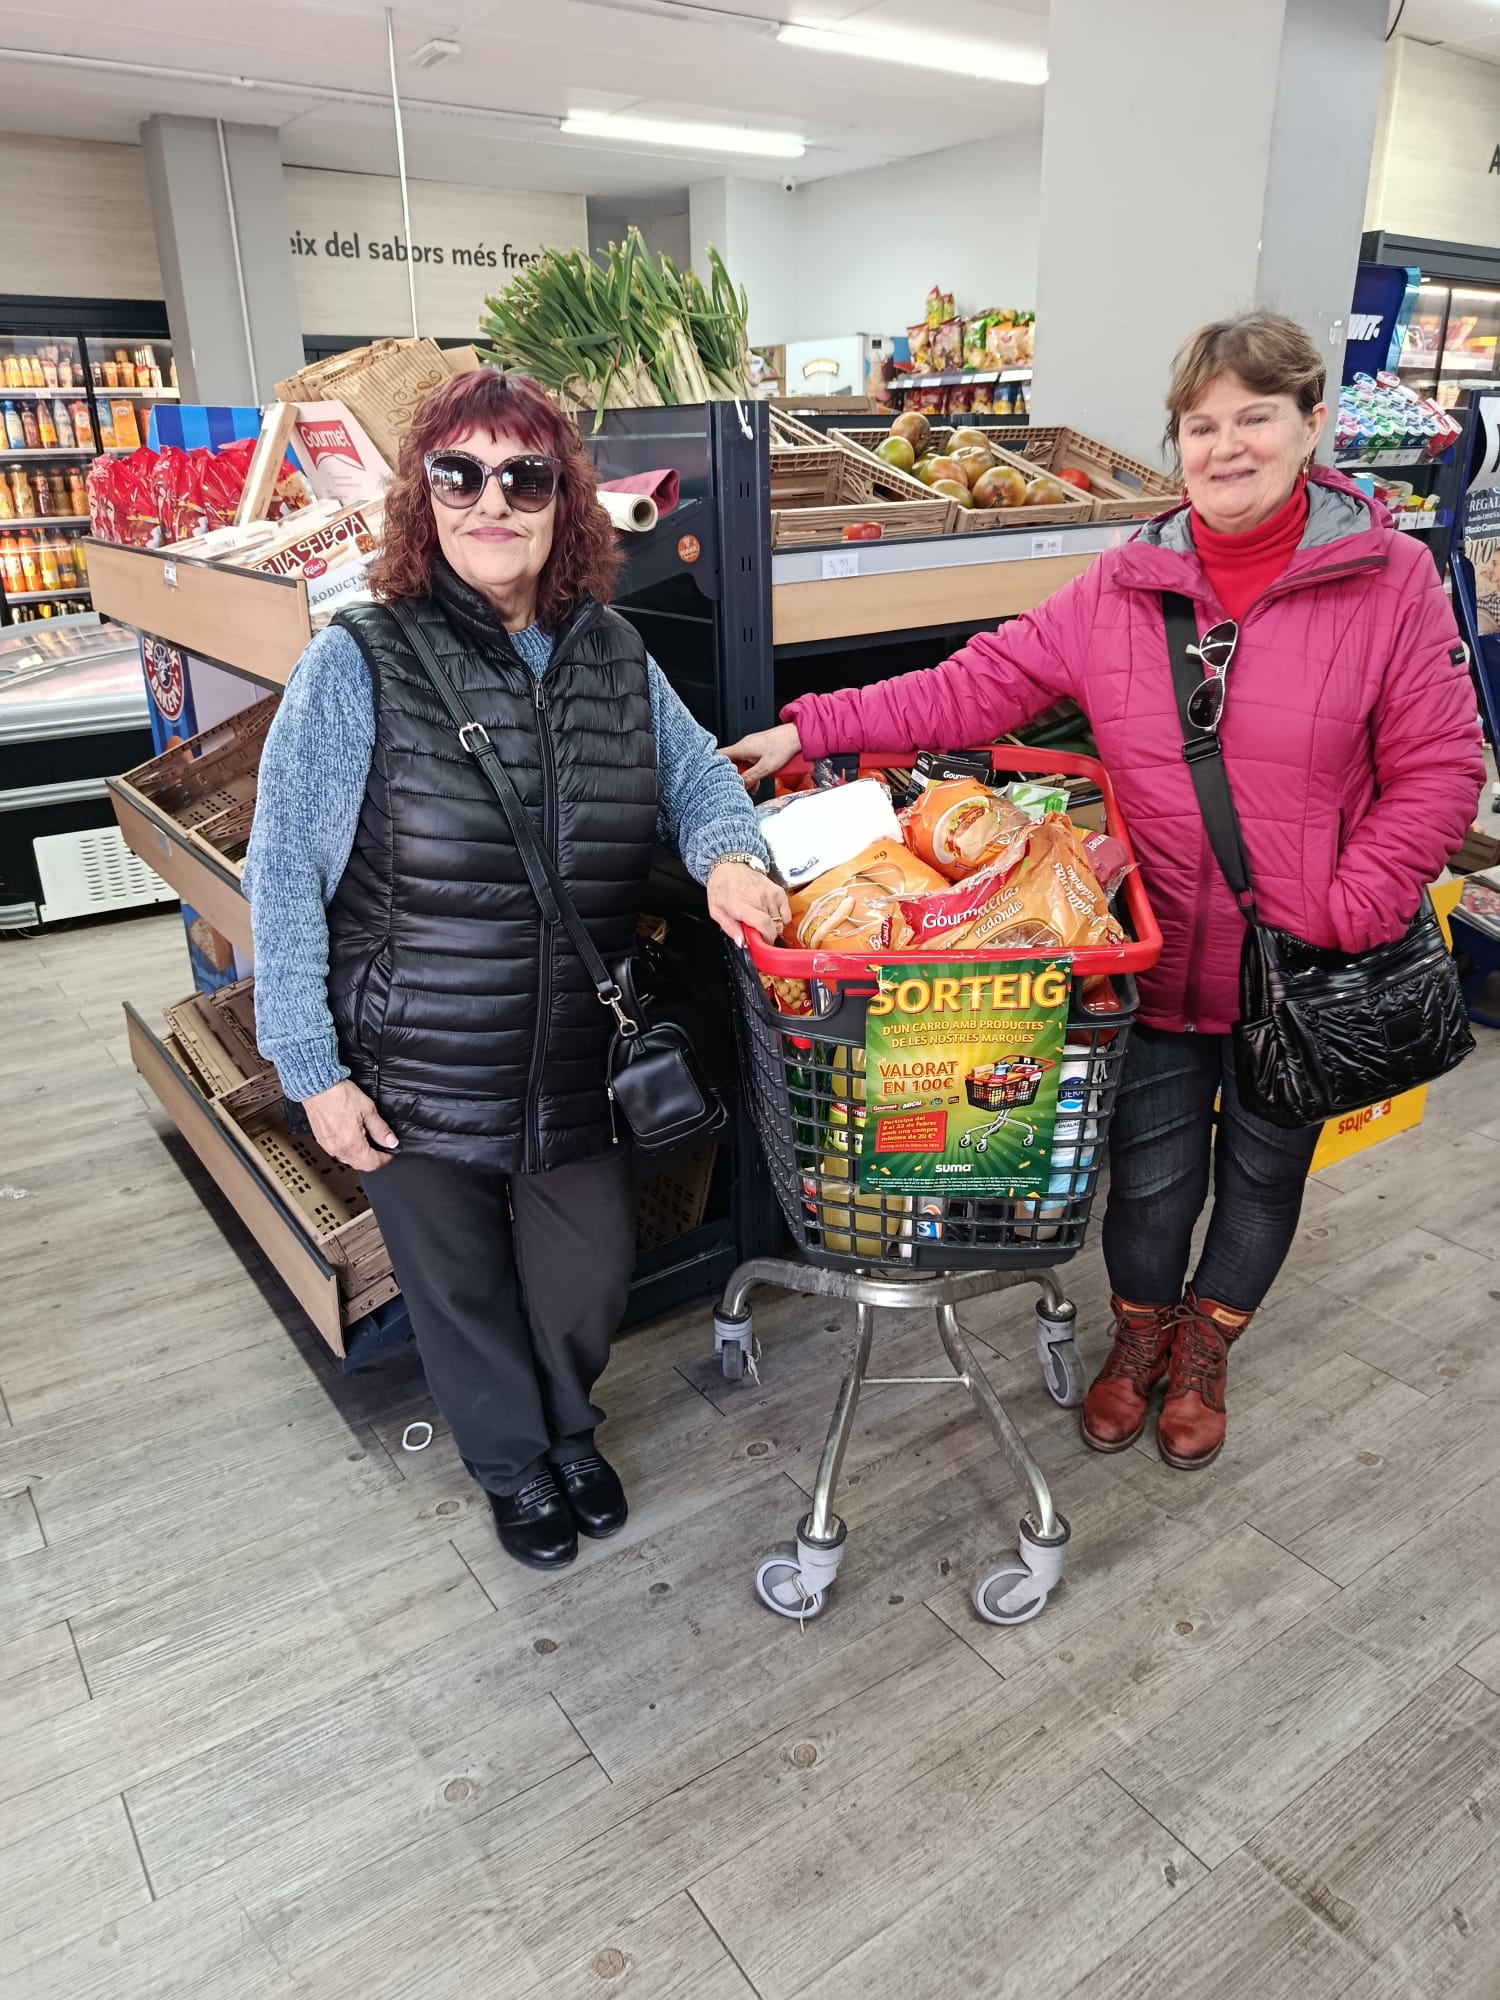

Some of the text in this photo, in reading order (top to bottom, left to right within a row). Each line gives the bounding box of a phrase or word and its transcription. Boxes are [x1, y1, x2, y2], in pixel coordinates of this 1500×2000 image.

[290, 229, 549, 269] ix del sabors més fres
[300, 425, 352, 449] Gourmet
[150, 675, 182, 713] BAKERY
[923, 908, 979, 929] Gourm
[974, 900, 1025, 939] redondas
[867, 970, 1067, 1017] SORTEIG
[882, 1019, 1044, 1037] D'UN CARRO AMB PRODUCTES
[892, 1033, 1035, 1048] DE LES NOSTRES MARQUES
[878, 1060, 959, 1080] VALORAT
[883, 1077, 954, 1096] EN 100€
[872, 1103, 898, 1112] Gourmet
[883, 1117, 913, 1126] Participa
[912, 1127, 938, 1135] compra
[935, 1163, 972, 1173] suma
